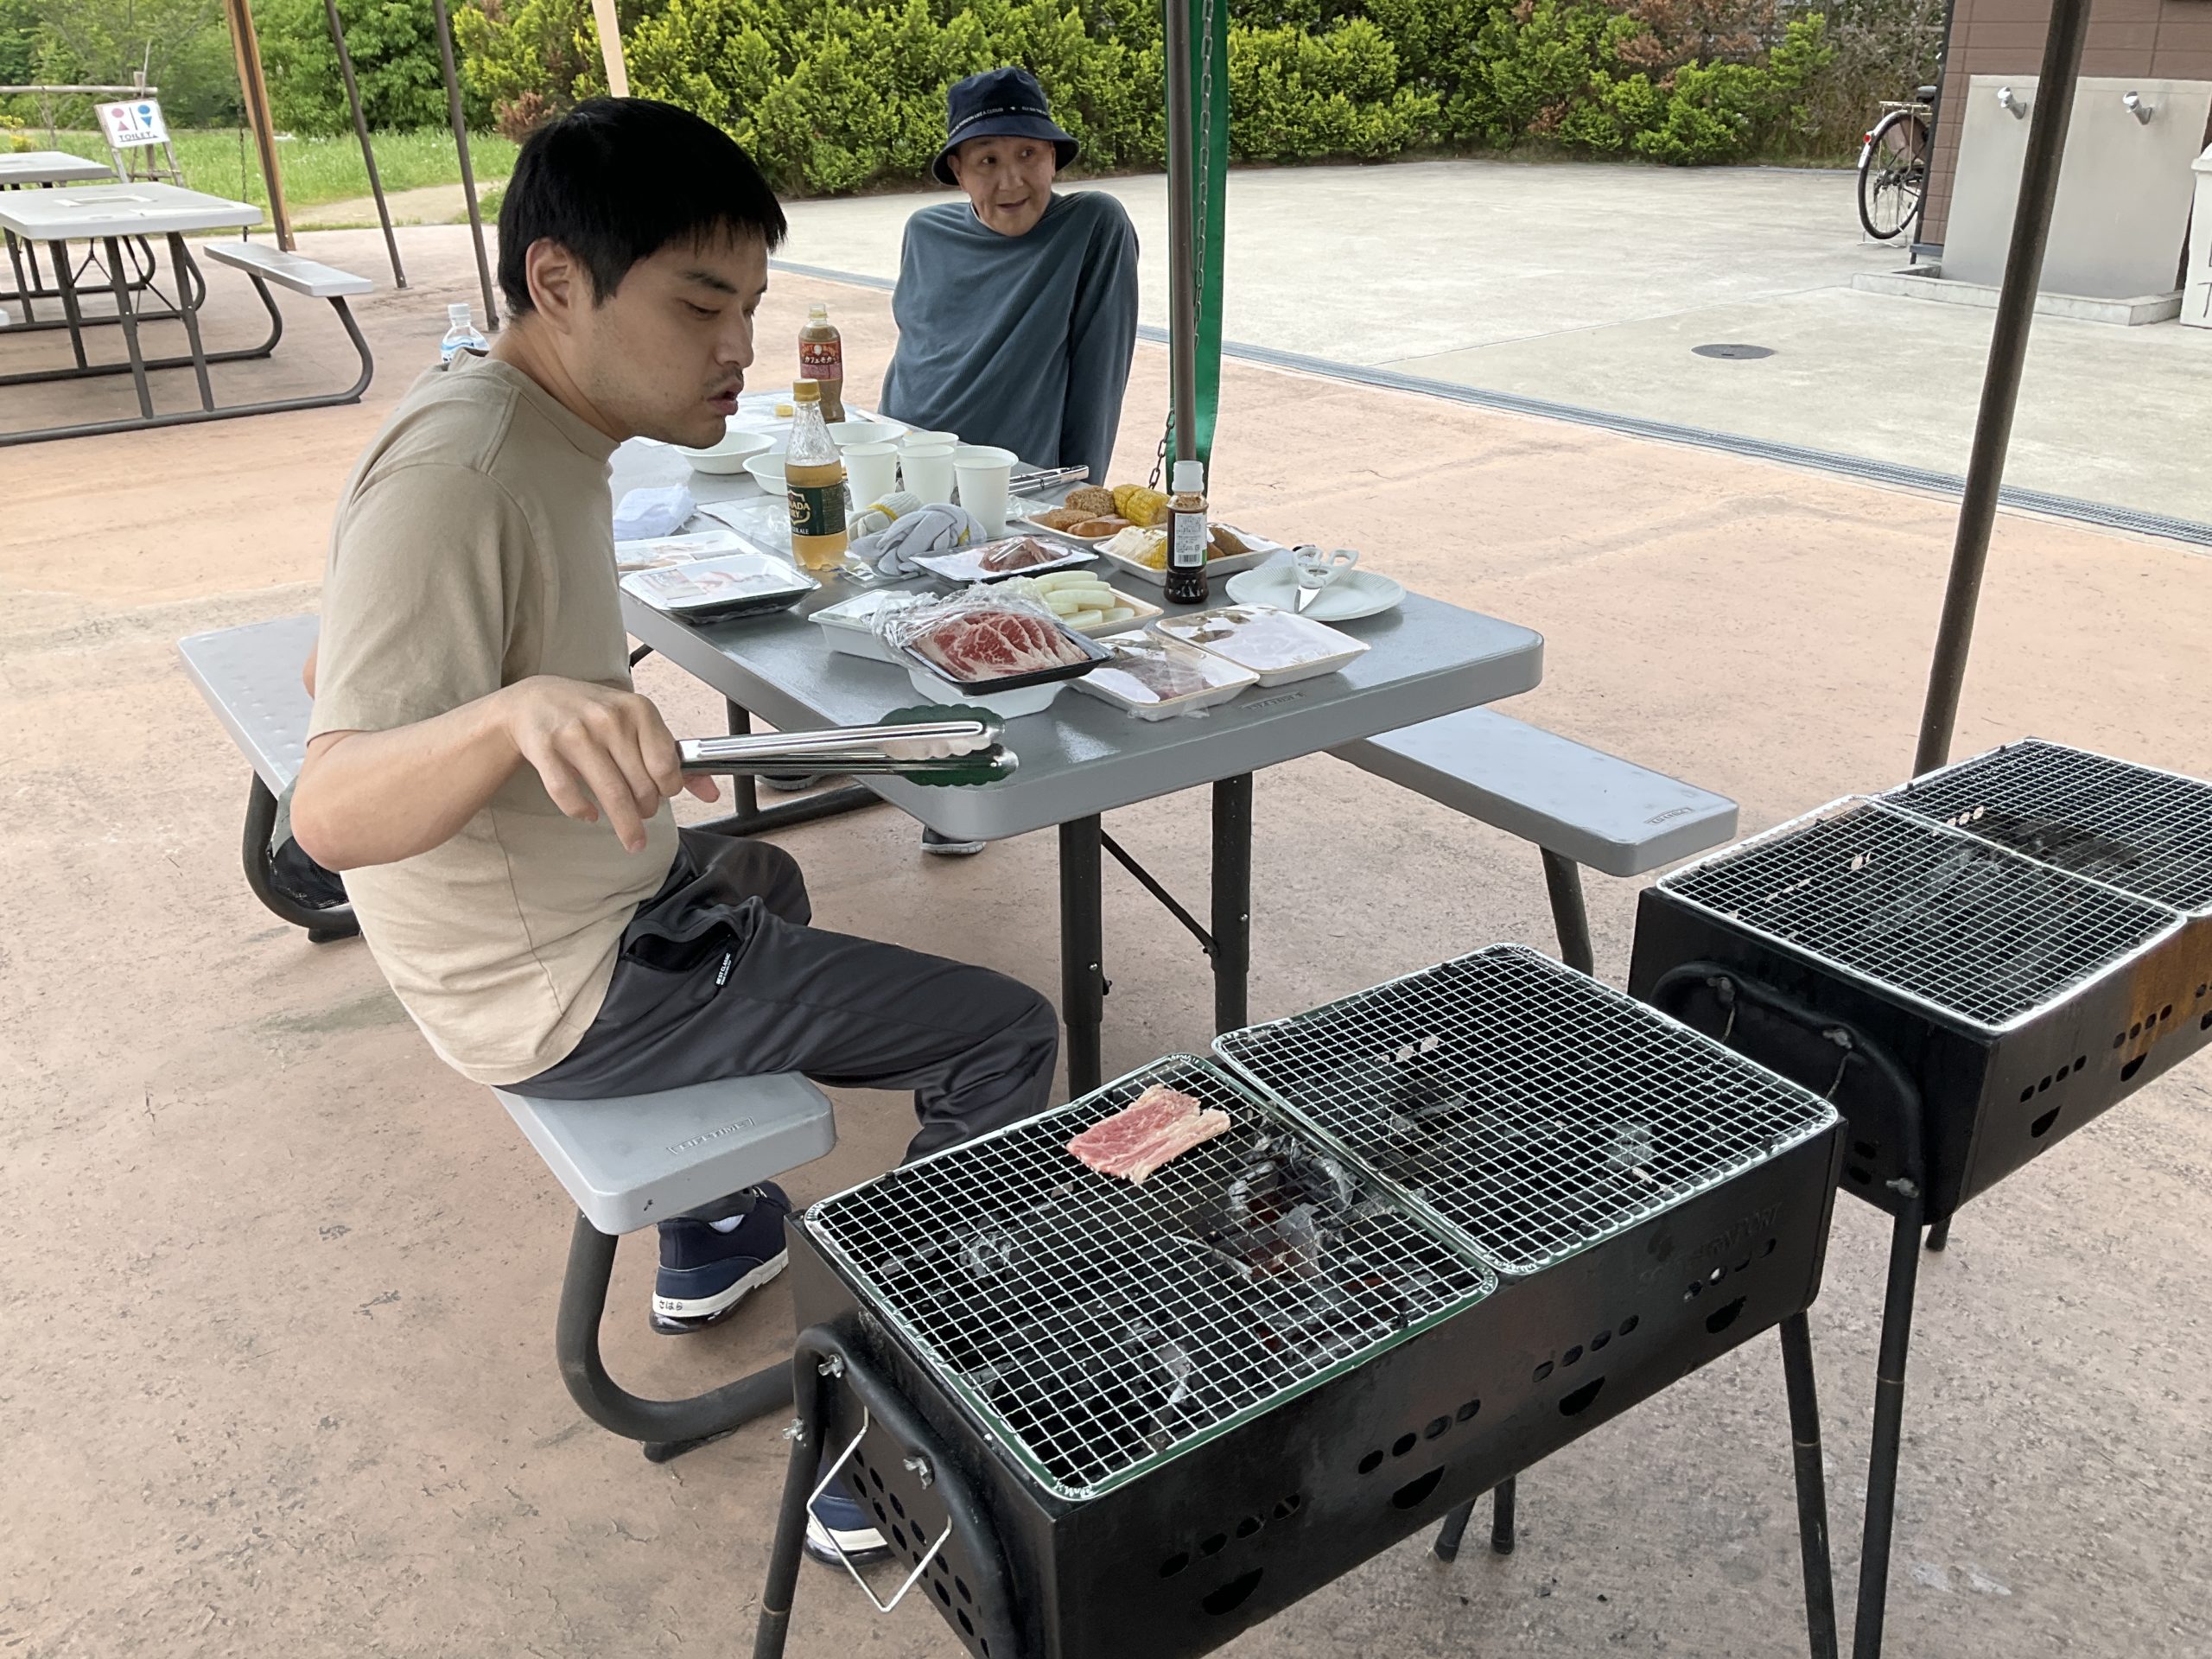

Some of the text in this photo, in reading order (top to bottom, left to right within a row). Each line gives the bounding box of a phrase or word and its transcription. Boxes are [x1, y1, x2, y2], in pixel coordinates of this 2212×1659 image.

[118, 131, 151, 142] TOILET
[715, 971, 724, 985] BEST
[659, 1300, 683, 1311] さはら
